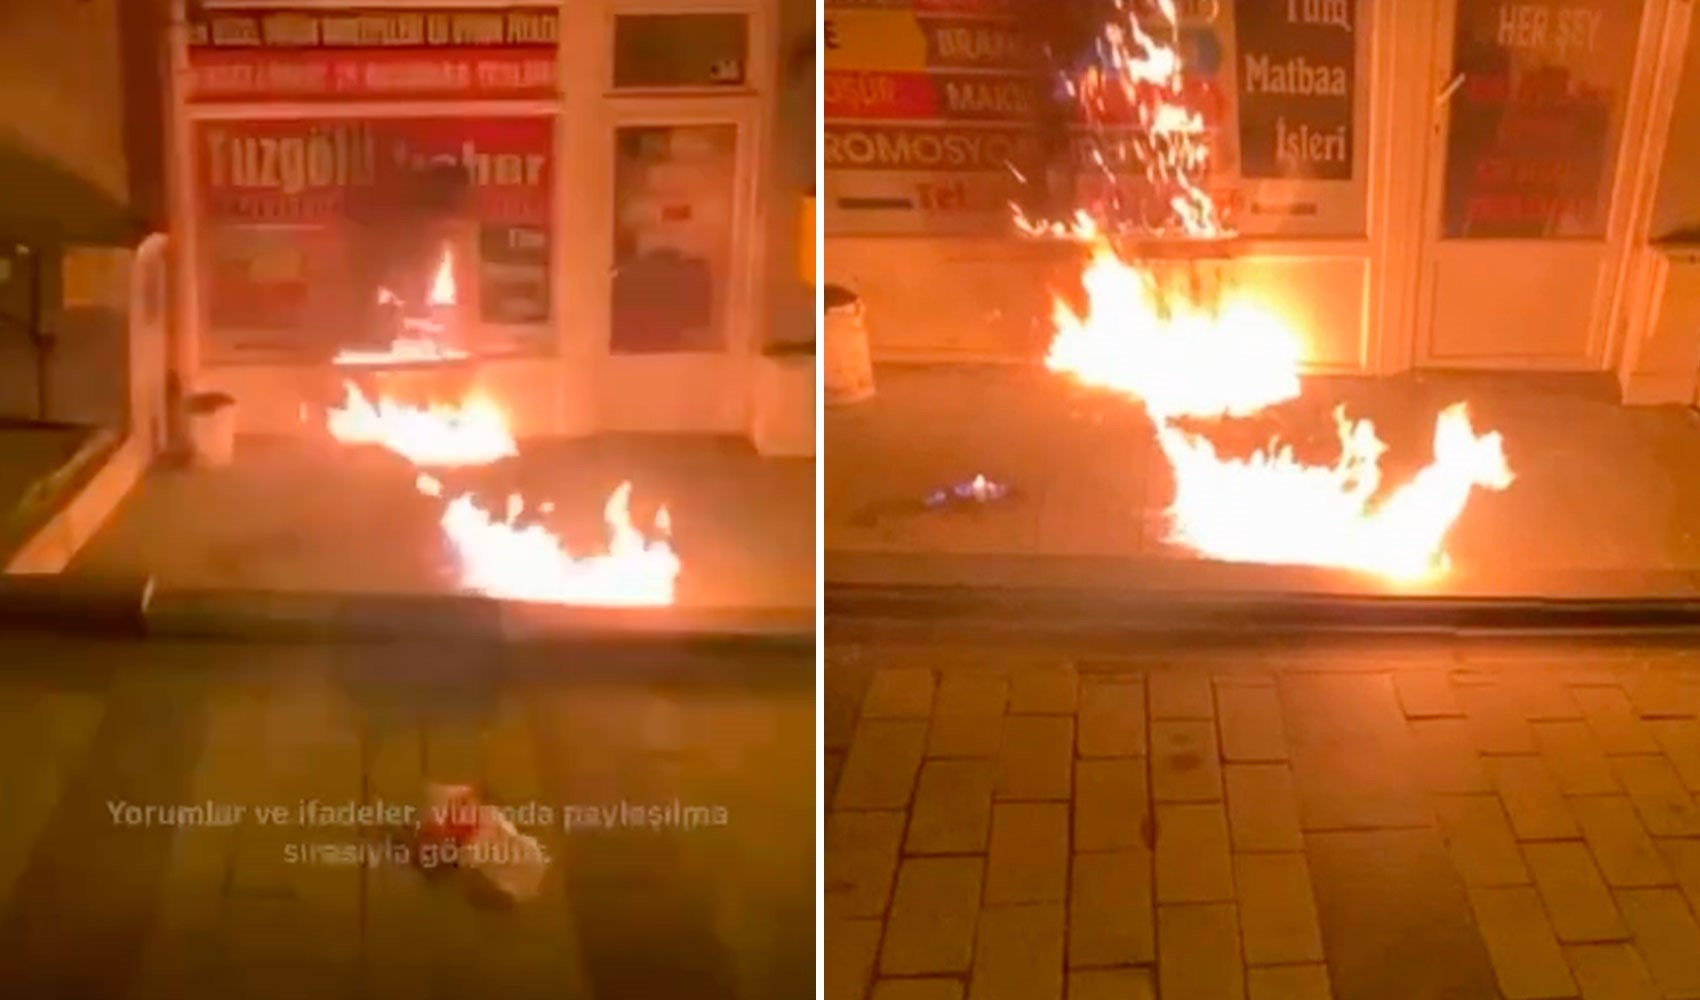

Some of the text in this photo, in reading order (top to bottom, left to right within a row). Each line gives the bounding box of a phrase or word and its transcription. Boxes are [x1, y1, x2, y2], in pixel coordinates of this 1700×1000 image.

[1498, 5, 1548, 47] HER
[1245, 54, 1346, 95] Matbaa
[1276, 117, 1346, 169] İşleri
